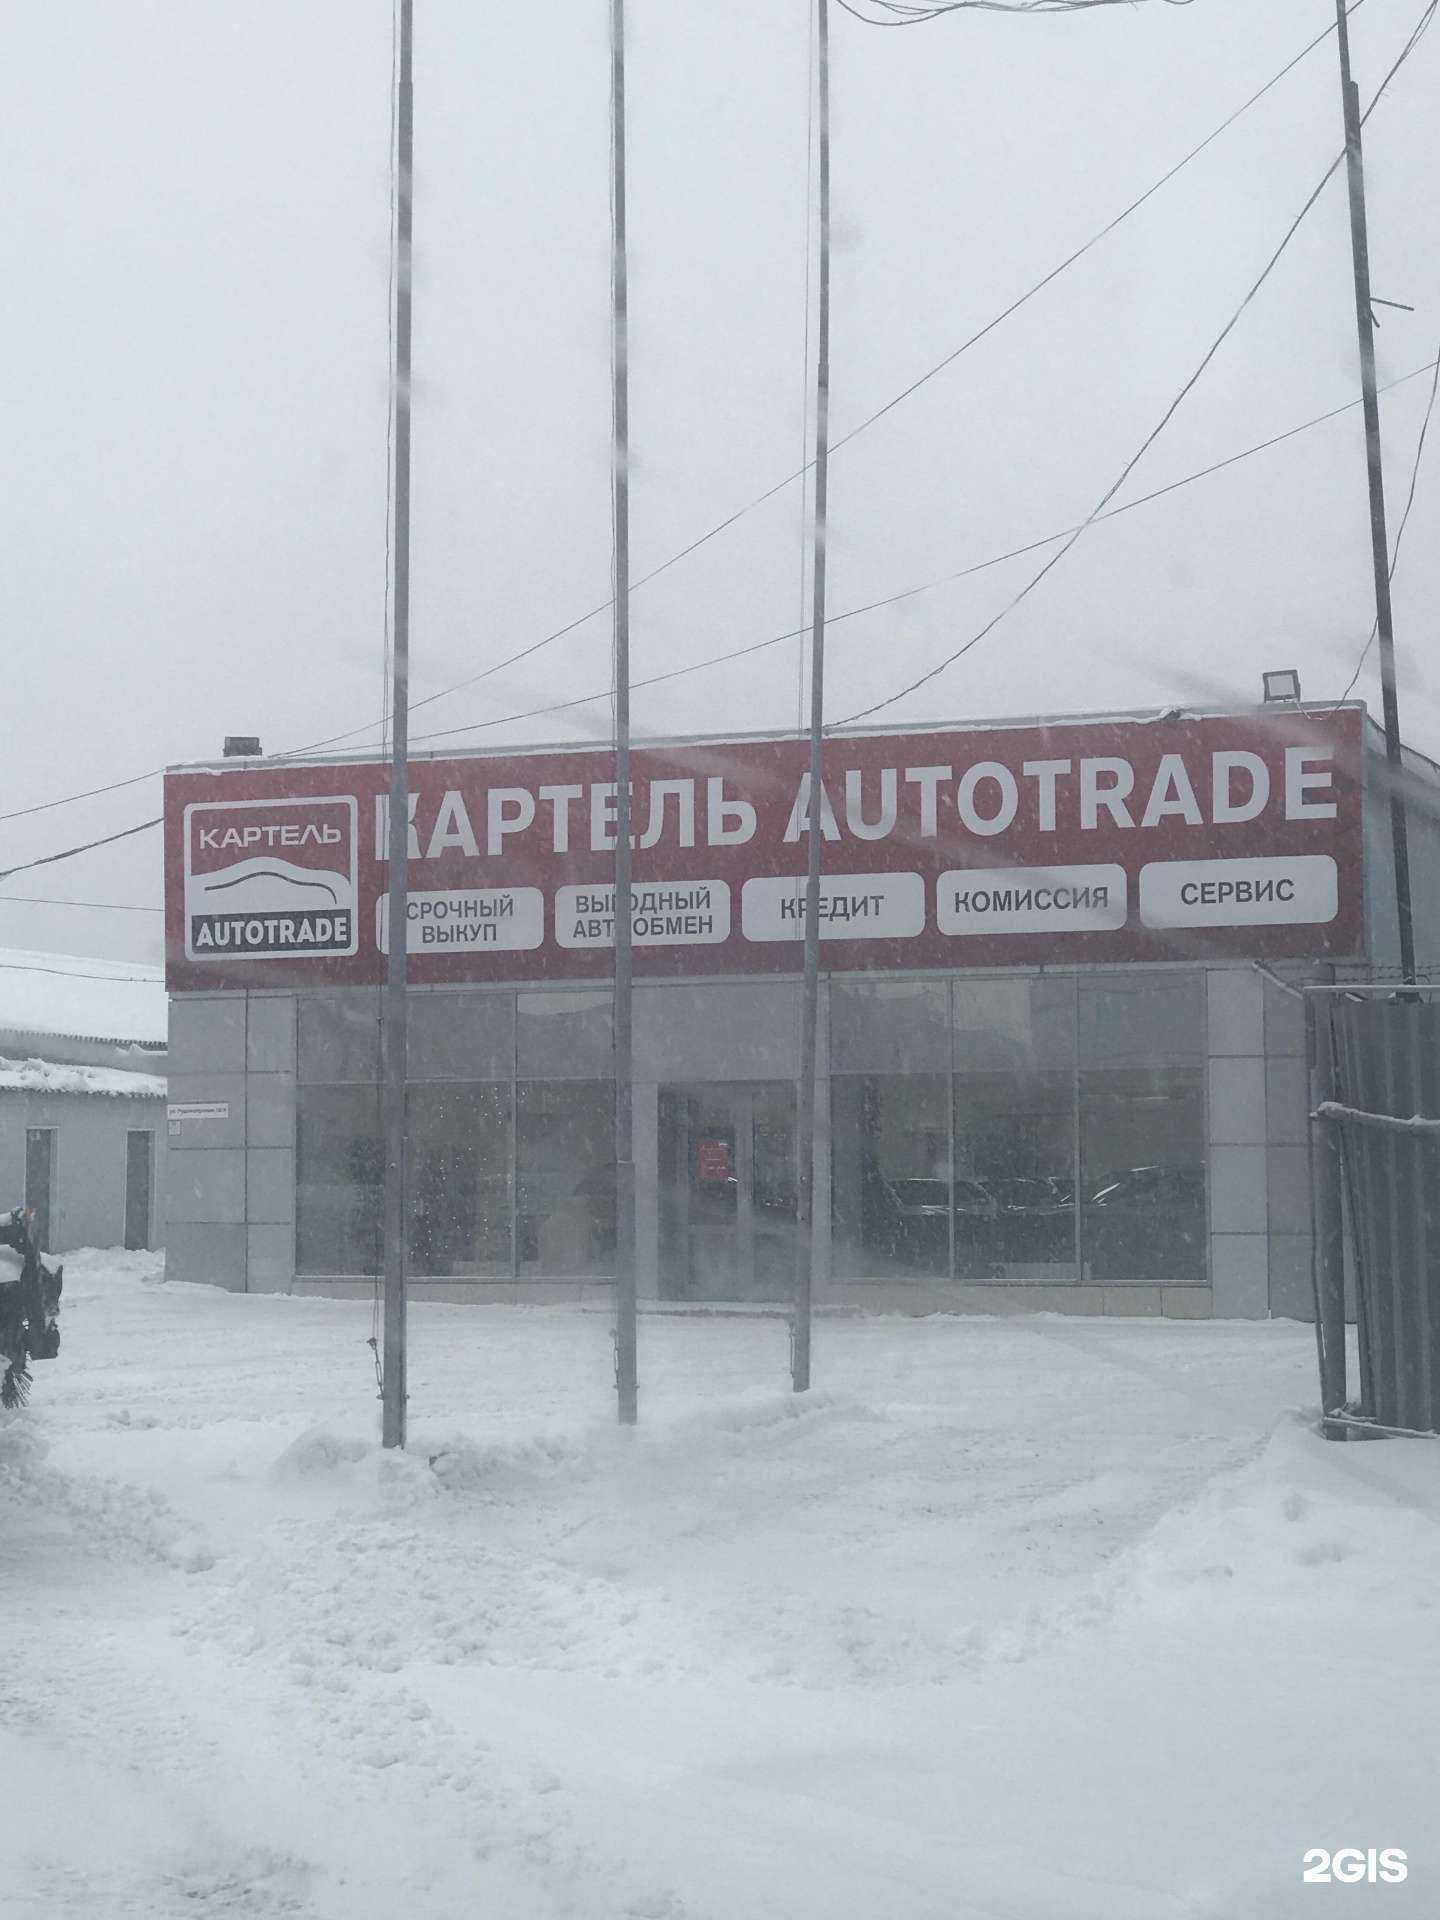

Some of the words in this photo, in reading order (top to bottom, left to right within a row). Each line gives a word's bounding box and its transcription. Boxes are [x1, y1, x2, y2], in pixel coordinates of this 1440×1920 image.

[375, 776, 757, 861] КАРТЕЛЬ
[783, 745, 1338, 843] AUTOTRADE
[199, 823, 342, 849] КАРТЕЛЬ
[954, 886, 1109, 914] КОМИССИЯ
[1180, 879, 1295, 906] СЕРВИС
[406, 894, 514, 920] СРОЧНЫЙ
[781, 895, 884, 922] КРЕДИТ
[196, 917, 348, 947] AUTOTRADE
[422, 923, 497, 944] ВЫКУП
[573, 915, 713, 938] АВТОБМЕН
